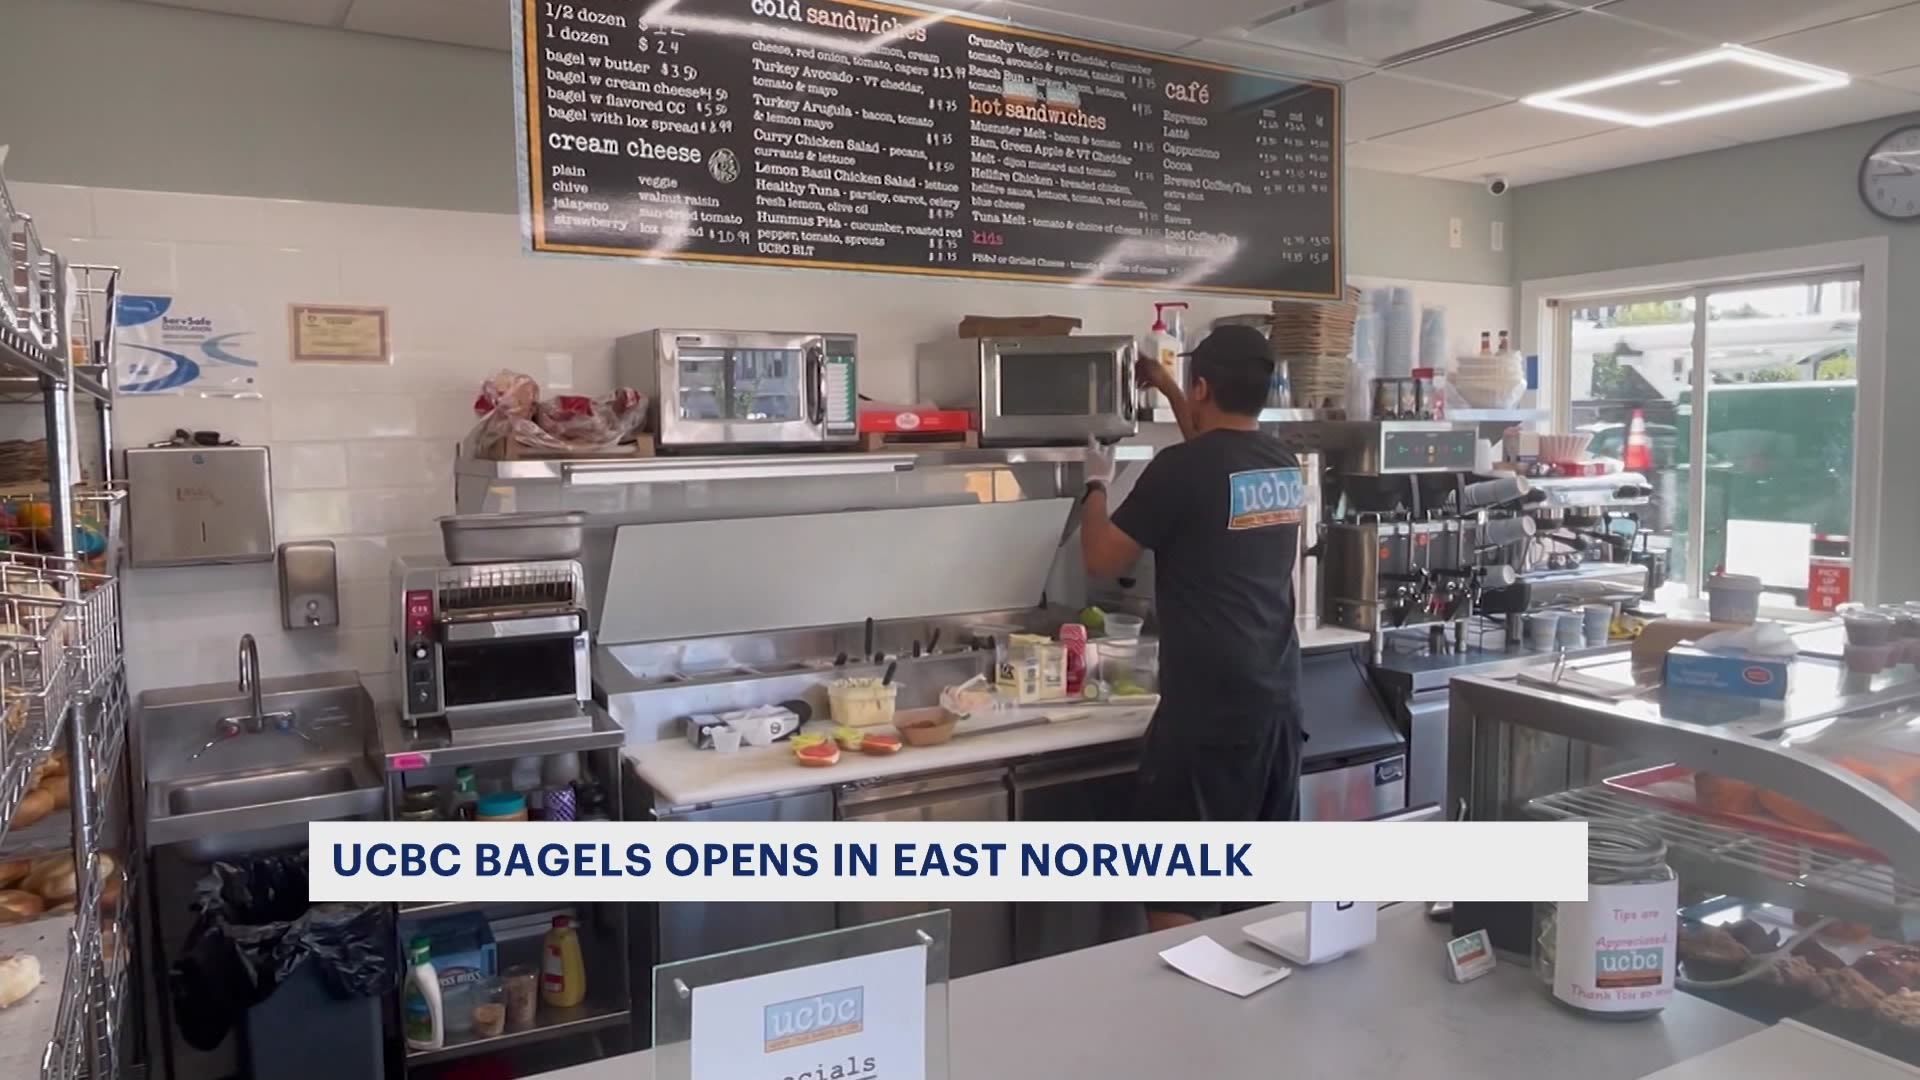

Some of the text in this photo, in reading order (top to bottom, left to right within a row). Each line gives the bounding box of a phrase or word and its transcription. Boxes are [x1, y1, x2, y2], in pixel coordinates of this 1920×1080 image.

[545, 2, 626, 28] 1/2 dozen
[751, 0, 802, 22] cold
[807, 7, 927, 42] sandwiches
[546, 24, 609, 46] 1 dozen
[752, 41, 928, 76] cheese, red onion, tomato, capers
[907, 51, 940, 63] cream
[968, 34, 1014, 54] Crunchy
[1016, 42, 1050, 58] Veggie
[1057, 50, 1069, 61] VT
[545, 48, 650, 74] bagel w butter
[968, 50, 1004, 65] tomato,
[1006, 56, 1043, 70] avocado
[1045, 62, 1053, 72] &
[968, 64, 1001, 79] Beach
[546, 68, 700, 98] bagel w cream cheese
[752, 58, 925, 94] Turkey Avocado VT cheddar,
[752, 76, 838, 97] tomato & mayo
[968, 81, 1002, 93] tomato
[547, 87, 685, 114] bagel w flavored CC
[1165, 81, 1209, 105] café
[547, 105, 698, 134] bagel with lox spread
[753, 94, 934, 128] Turkey Arugula bacon, tomato
[754, 111, 834, 130] & lemon mayo
[969, 95, 1003, 116] hot
[1006, 102, 1106, 130] sandwiches
[1163, 110, 1208, 126] Espresso
[754, 129, 792, 146] Curry
[795, 133, 844, 150] Chicken
[847, 140, 880, 153] Salad
[970, 120, 1021, 136] Muenster
[1024, 126, 1046, 139] Melt
[1082, 136, 1088, 145] &
[1092, 137, 1122, 149] tomato
[549, 132, 702, 163] cream cheese
[754, 147, 855, 166] currants & lettuce
[970, 136, 999, 150] Ham,
[1001, 138, 1033, 152] Green
[1035, 144, 1064, 158] Apple
[1066, 148, 1075, 158] &
[1076, 149, 1090, 159] VT
[971, 152, 996, 164] Melt
[1028, 160, 1066, 172] mustard
[1068, 164, 1084, 174] and
[1087, 167, 1117, 178] tomato
[1163, 158, 1193, 171] Cocoa
[552, 164, 678, 188] plain veggie
[755, 162, 959, 193] Lemon Basil Chicken Salad lettuce
[971, 168, 1010, 181] Hellfire
[1012, 172, 1053, 186] Chicken
[1164, 175, 1201, 188] Brewed
[552, 180, 719, 208] chive walnut raisin
[756, 179, 806, 196] Healthy
[808, 184, 840, 197] Tuna
[849, 190, 891, 204] parsley,
[929, 197, 960, 210] celery
[756, 195, 868, 214] fresh lemon, olive oil
[971, 197, 992, 208] blue
[1106, 198, 1121, 206] red
[552, 197, 743, 225] jalapeno tomato
[554, 213, 629, 231] strawberry
[972, 211, 1000, 223] Tuna
[1002, 214, 1026, 225] Melt
[757, 211, 963, 238] Hummus Pita cucumber, roasted red
[758, 229, 885, 248] pepper, tomato, sprouts
[973, 231, 1003, 245] kids
[758, 243, 815, 256] UCBC BLT
[162, 316, 212, 325] ServSafe
[1612, 908, 1659, 923] Tips are
[1595, 932, 1668, 950] Appreciated
[1602, 951, 1658, 972] ucbc
[1570, 983, 1611, 1000] Thank
[772, 996, 856, 1036] ucbc
[782, 1056, 877, 1080] cials
